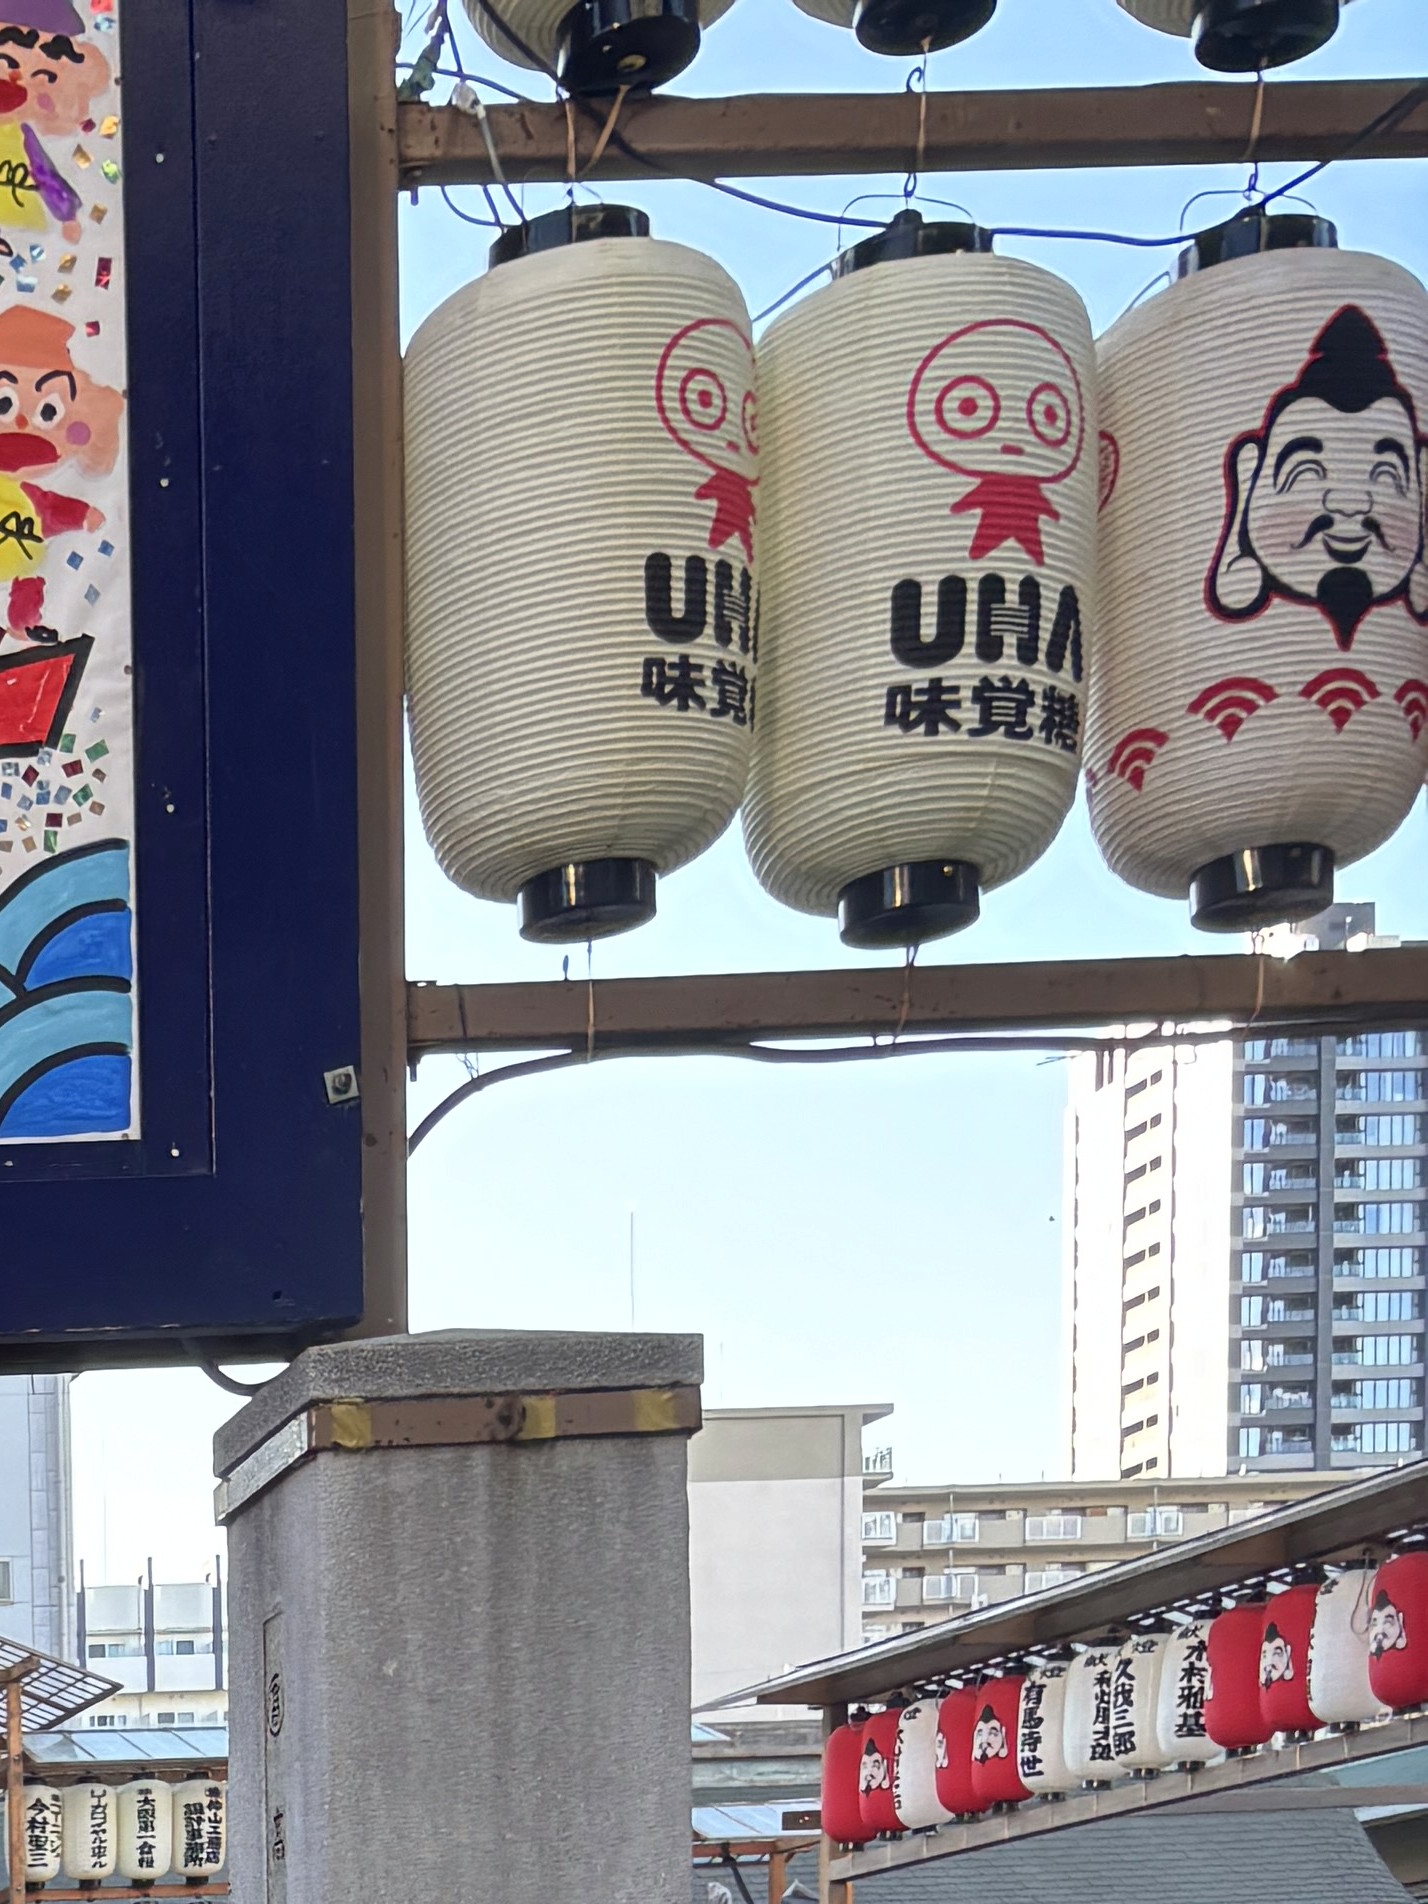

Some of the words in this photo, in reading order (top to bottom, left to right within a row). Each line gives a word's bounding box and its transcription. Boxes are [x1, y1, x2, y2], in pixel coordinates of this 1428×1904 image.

[644, 551, 760, 665] UH
[889, 572, 1084, 684] UHA
[641, 653, 757, 735] 味覚
[883, 673, 1080, 754] 味覚糖
